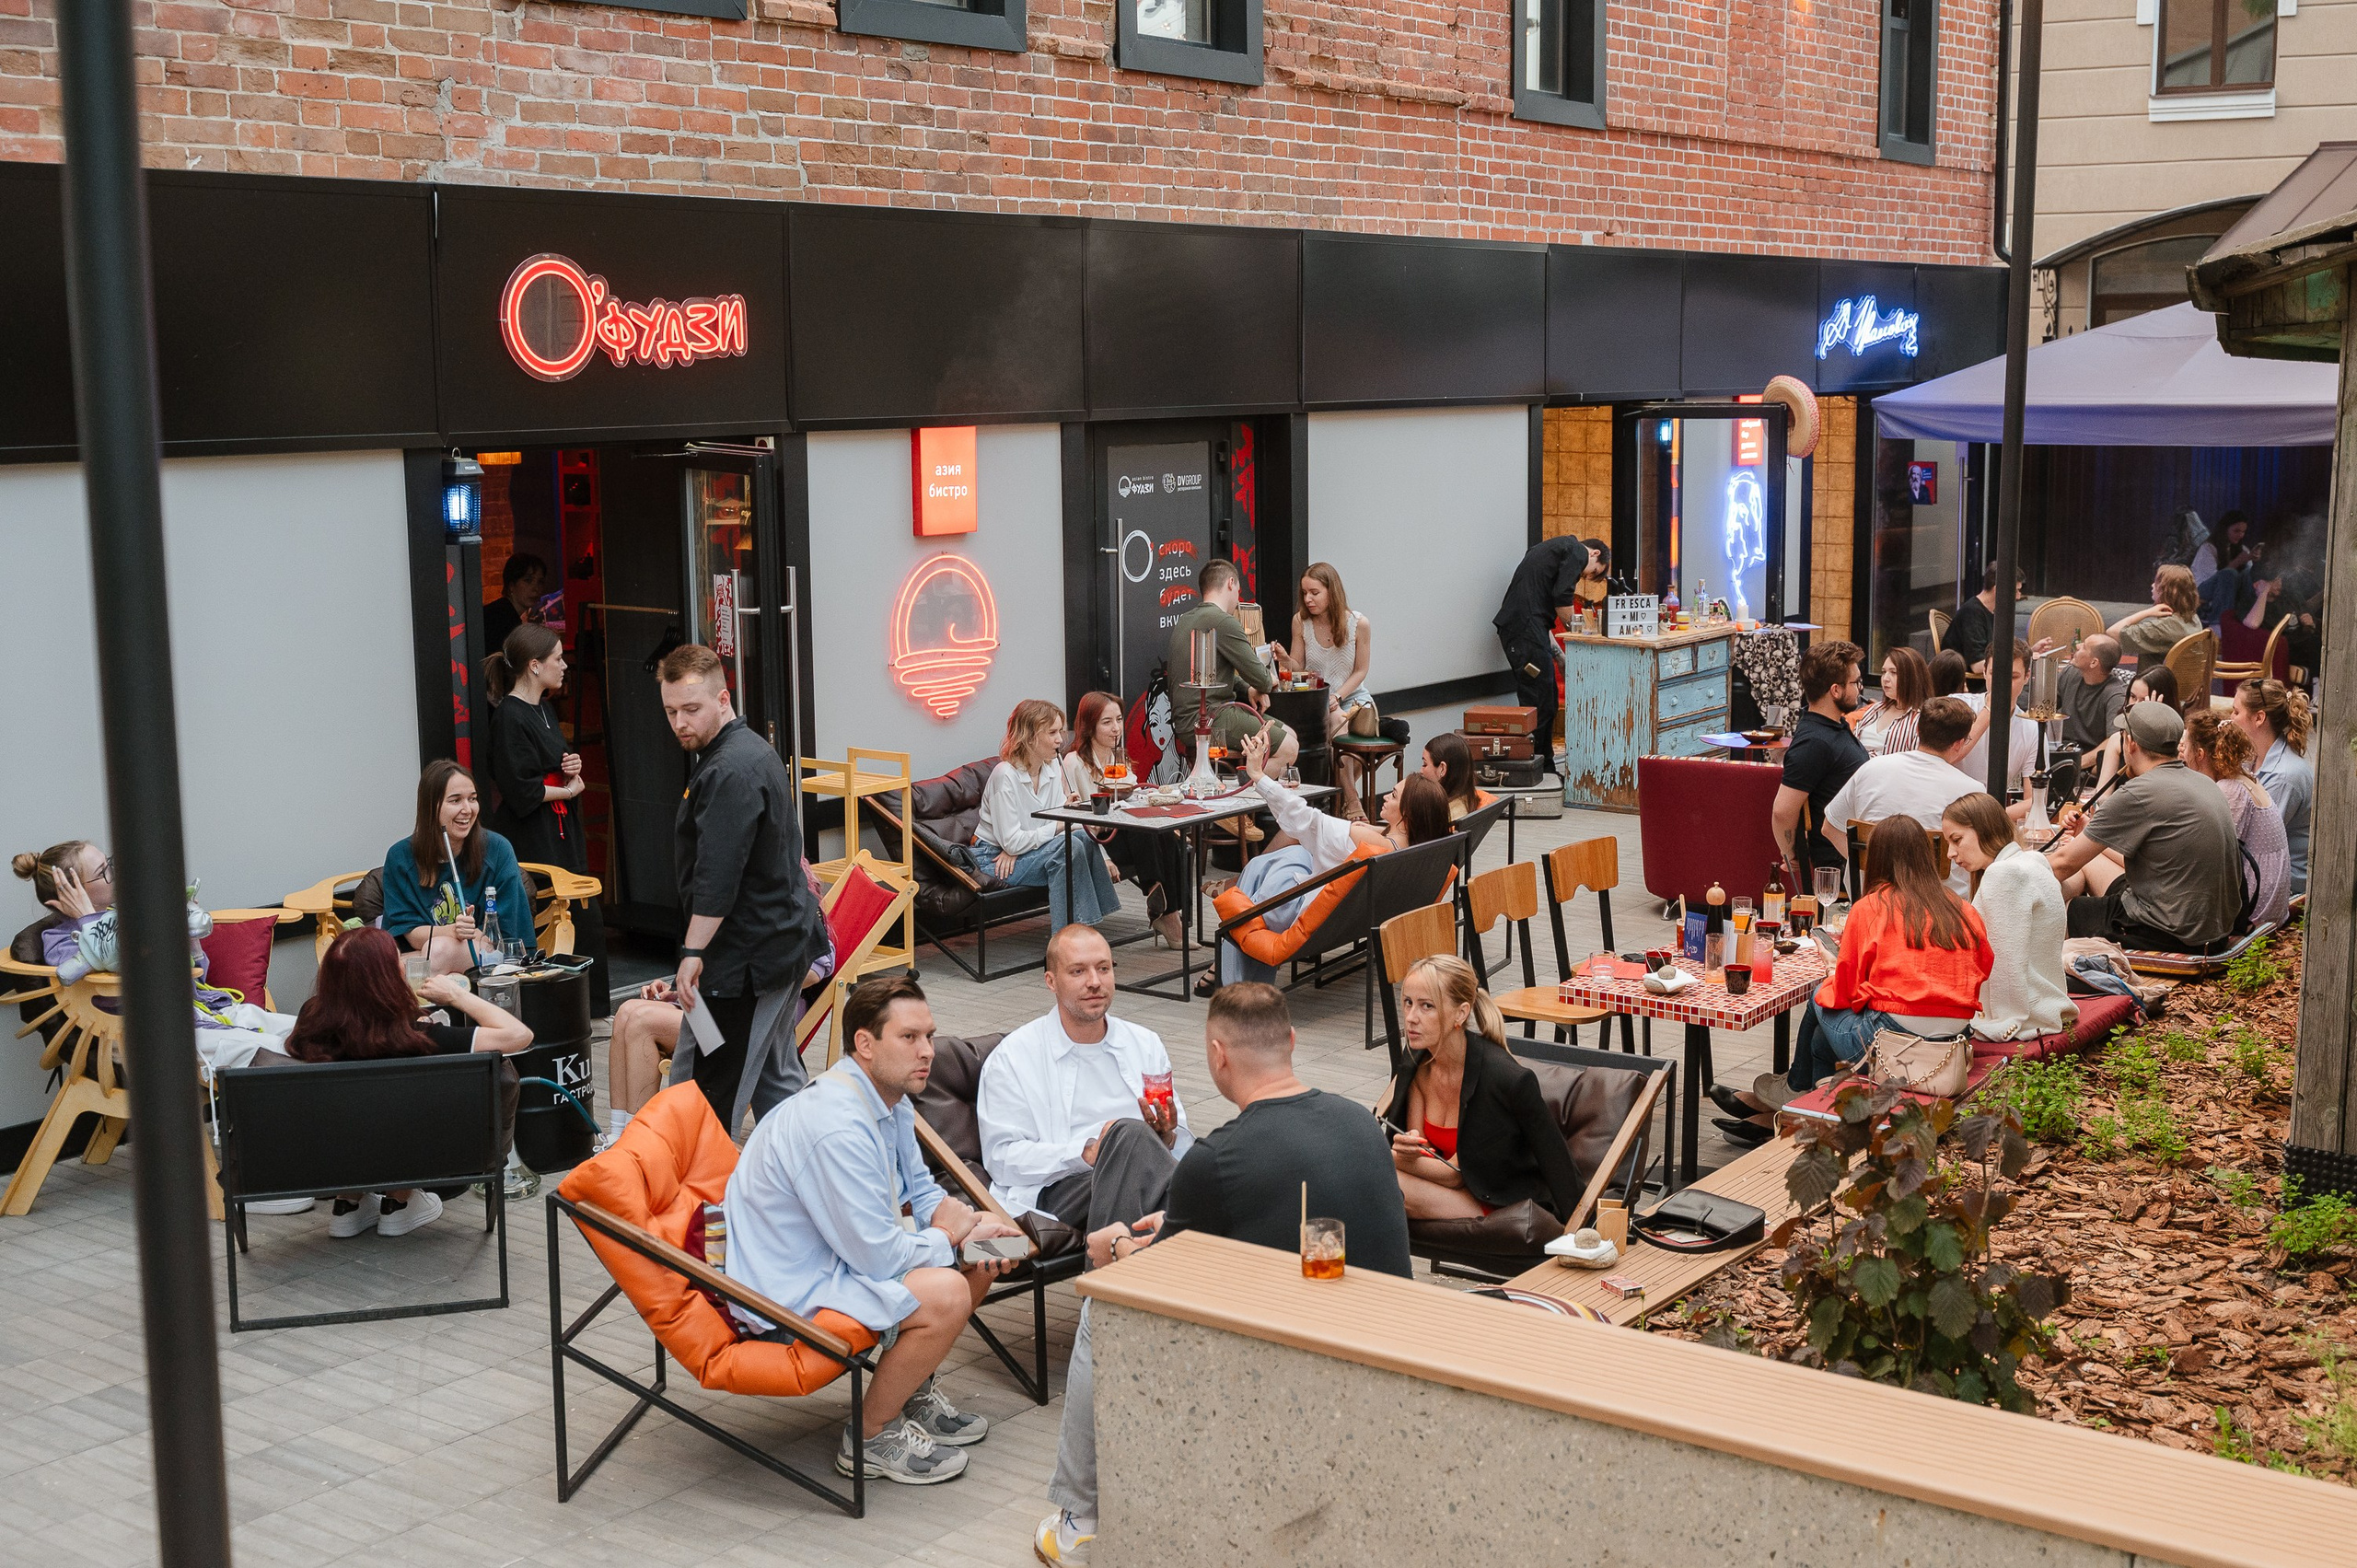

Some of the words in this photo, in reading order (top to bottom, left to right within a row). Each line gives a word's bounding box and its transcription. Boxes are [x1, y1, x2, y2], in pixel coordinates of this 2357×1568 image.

[935, 464, 961, 476] азия
[929, 483, 968, 499] бистро
[1158, 540, 1192, 558] скоро
[1159, 564, 1191, 582] здесь
[1159, 587, 1192, 607] будет
[1159, 613, 1184, 629] вку
[1630, 611, 1639, 621] MI
[552, 1081, 593, 1105] ГАСТРО
[912, 1405, 935, 1423] N
[882, 1445, 905, 1462] N
